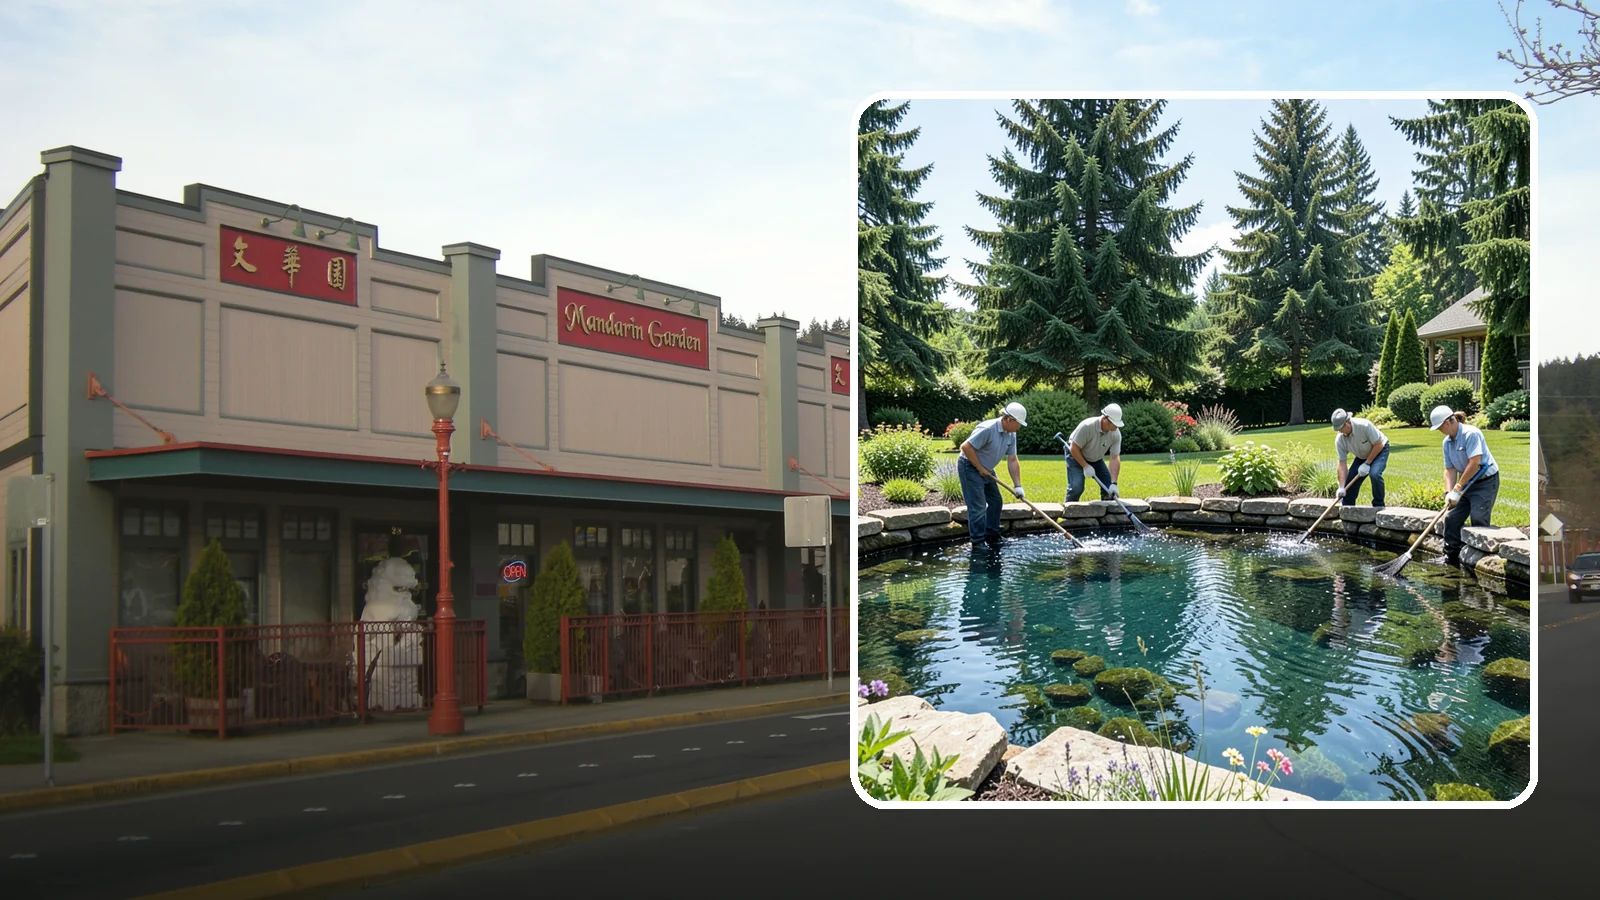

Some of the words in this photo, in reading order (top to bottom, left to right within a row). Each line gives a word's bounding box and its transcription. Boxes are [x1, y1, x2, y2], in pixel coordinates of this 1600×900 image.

[230, 236, 346, 291] 文華園
[565, 302, 644, 341] Mandarin
[648, 320, 701, 352] Garden
[834, 363, 846, 386] 文
[503, 565, 527, 578] OPEN
